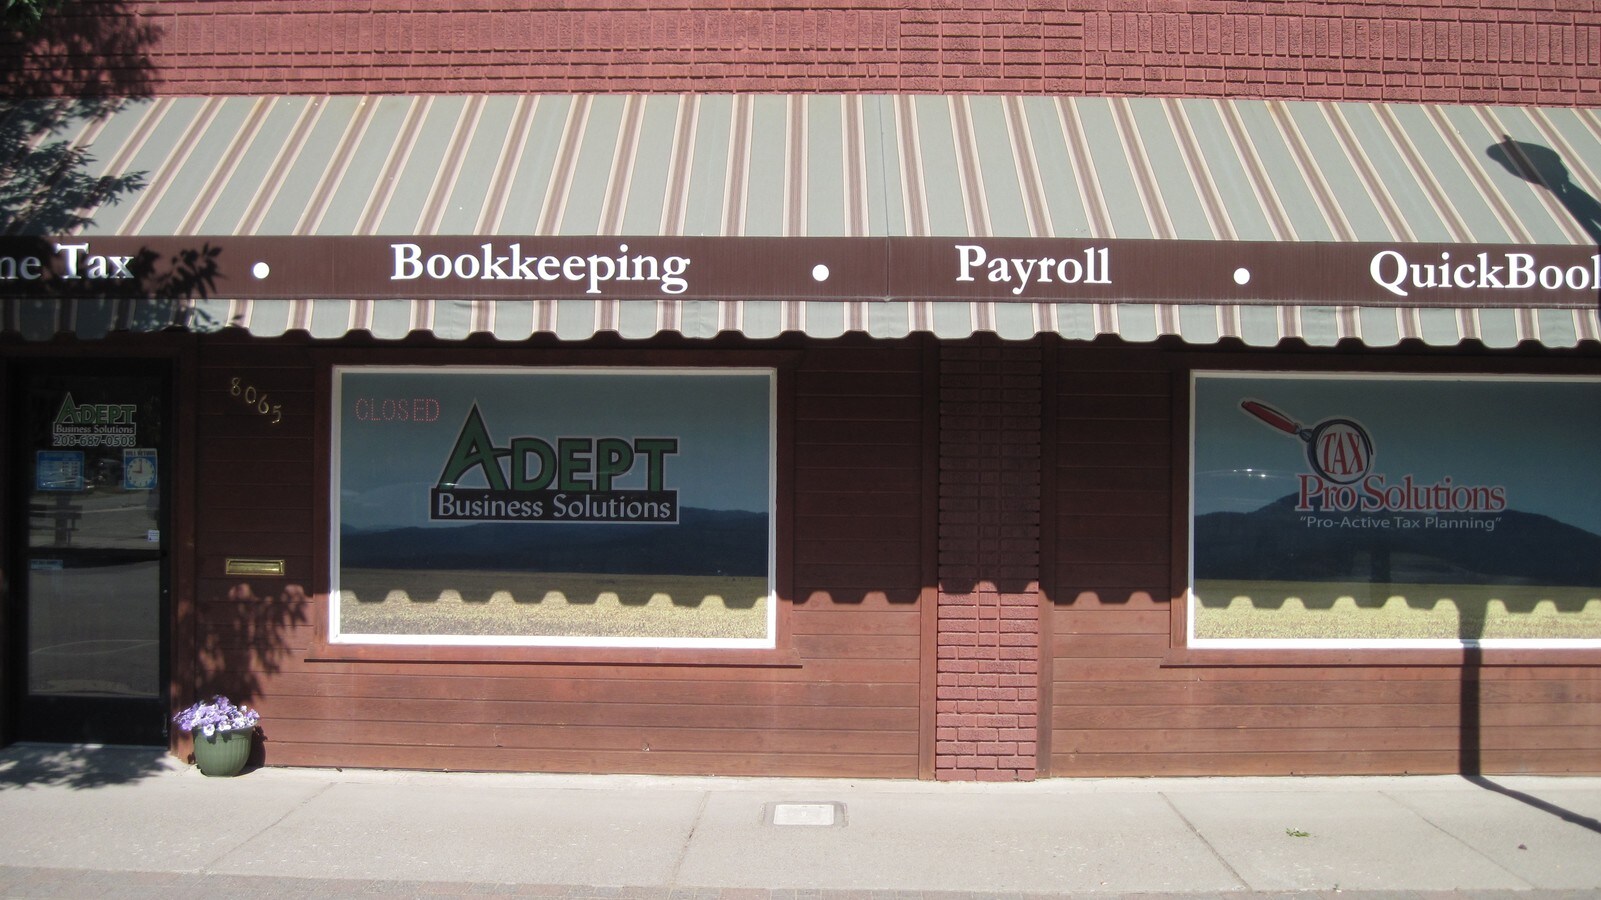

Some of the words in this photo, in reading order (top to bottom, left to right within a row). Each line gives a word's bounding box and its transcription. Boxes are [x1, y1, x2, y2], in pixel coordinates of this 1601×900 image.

[55, 242, 135, 280] Tax
[390, 243, 691, 294] Bookkeeping
[954, 244, 1112, 295] Payroll
[230, 376, 282, 424] 8065
[355, 398, 440, 421] CLOSED
[53, 434, 136, 446] 208-687-0508
[56, 424, 91, 433] Business
[94, 424, 134, 433] Solutions
[1322, 432, 1364, 475] TAX
[438, 493, 544, 518] Business
[553, 493, 671, 519] Solutions
[1296, 474, 1356, 511] Pro
[1362, 474, 1506, 512] Solutions
[1395, 517, 1420, 529] Tax
